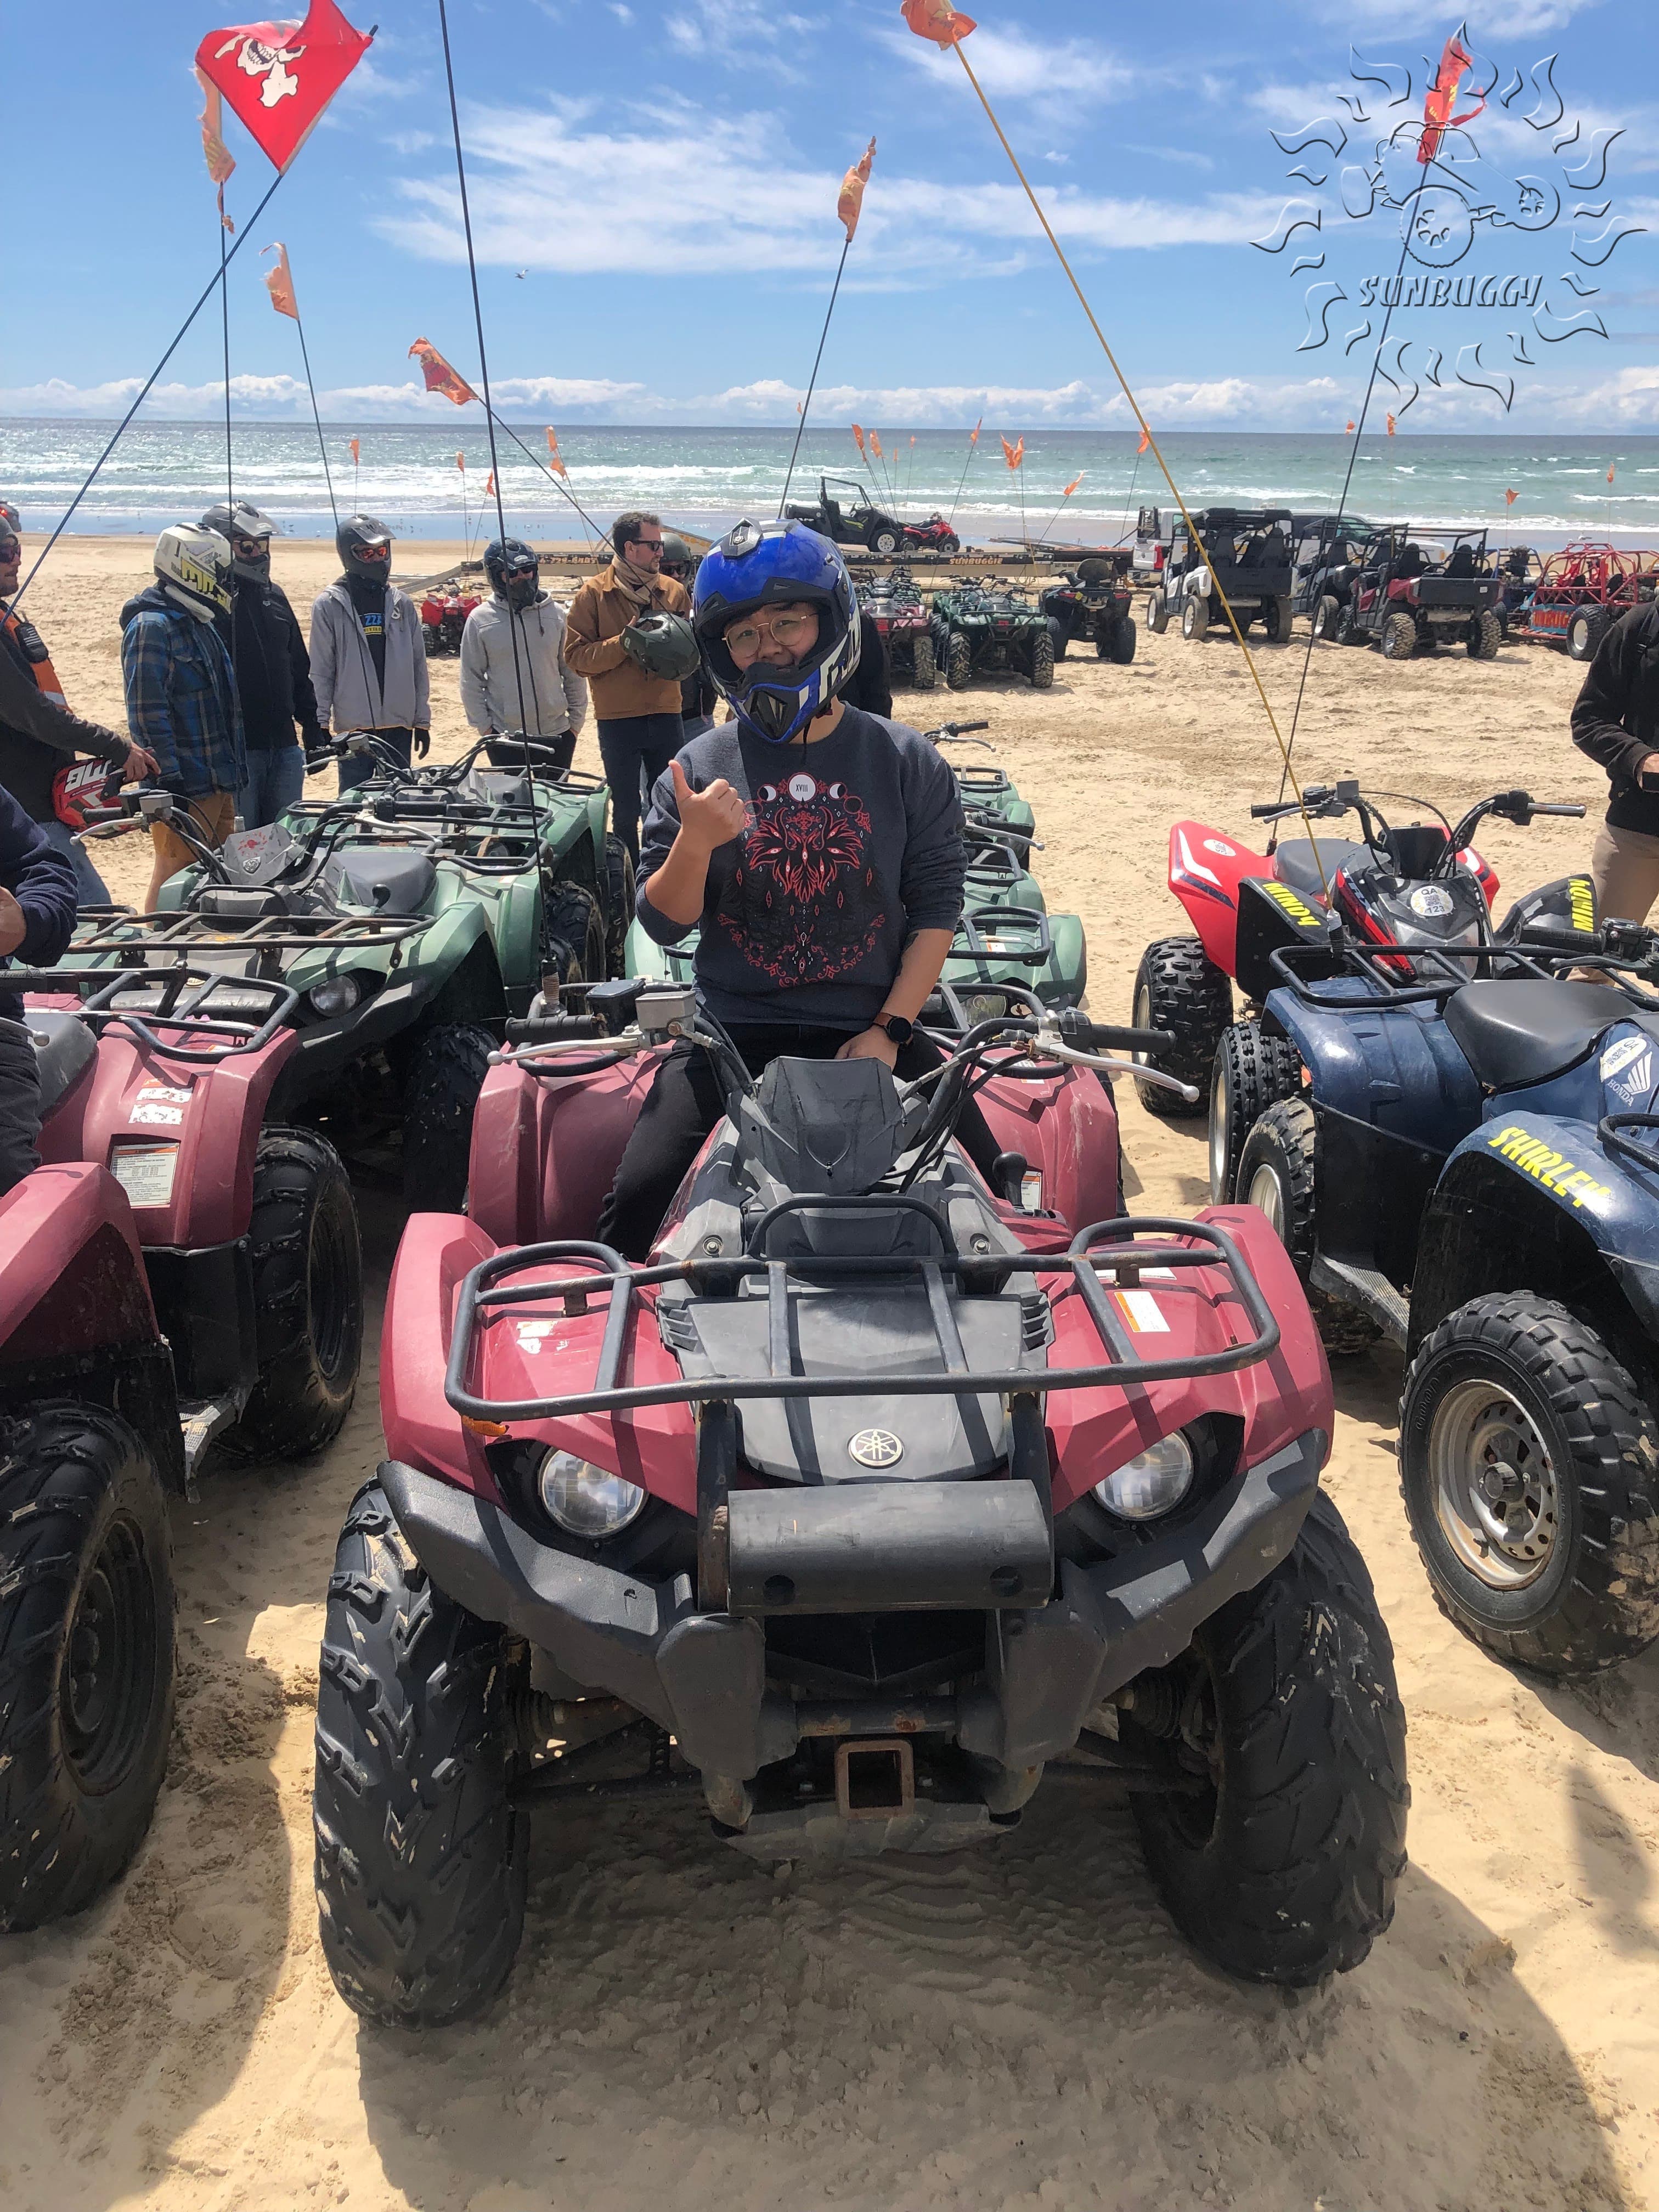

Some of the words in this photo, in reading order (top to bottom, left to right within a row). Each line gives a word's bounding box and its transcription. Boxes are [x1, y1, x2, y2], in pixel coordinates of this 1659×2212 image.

[795, 783, 808, 792] XVIII
[1262, 883, 1322, 926] MINDY
[1426, 905, 1446, 913] 123
[1568, 878, 1594, 933] MINDY
[1606, 1079, 1635, 1107] HONDA
